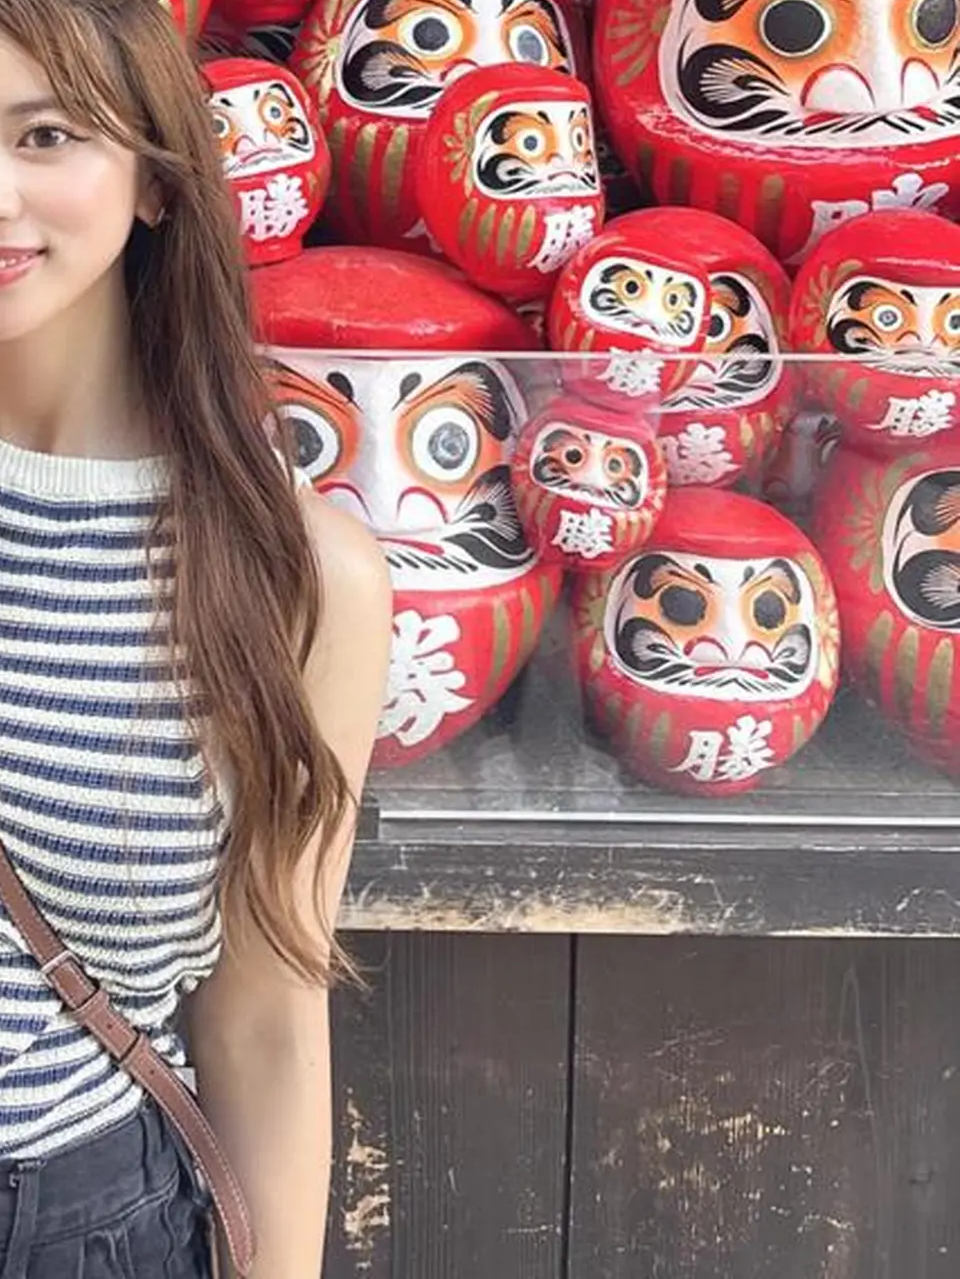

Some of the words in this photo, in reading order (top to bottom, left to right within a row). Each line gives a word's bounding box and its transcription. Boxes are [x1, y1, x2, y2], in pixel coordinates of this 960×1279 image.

[240, 173, 309, 242] 勝
[530, 205, 598, 272] 勝
[598, 346, 665, 397] 勝
[864, 390, 956, 436] 勝
[552, 507, 614, 558] 勝
[672, 714, 774, 782] 勝
